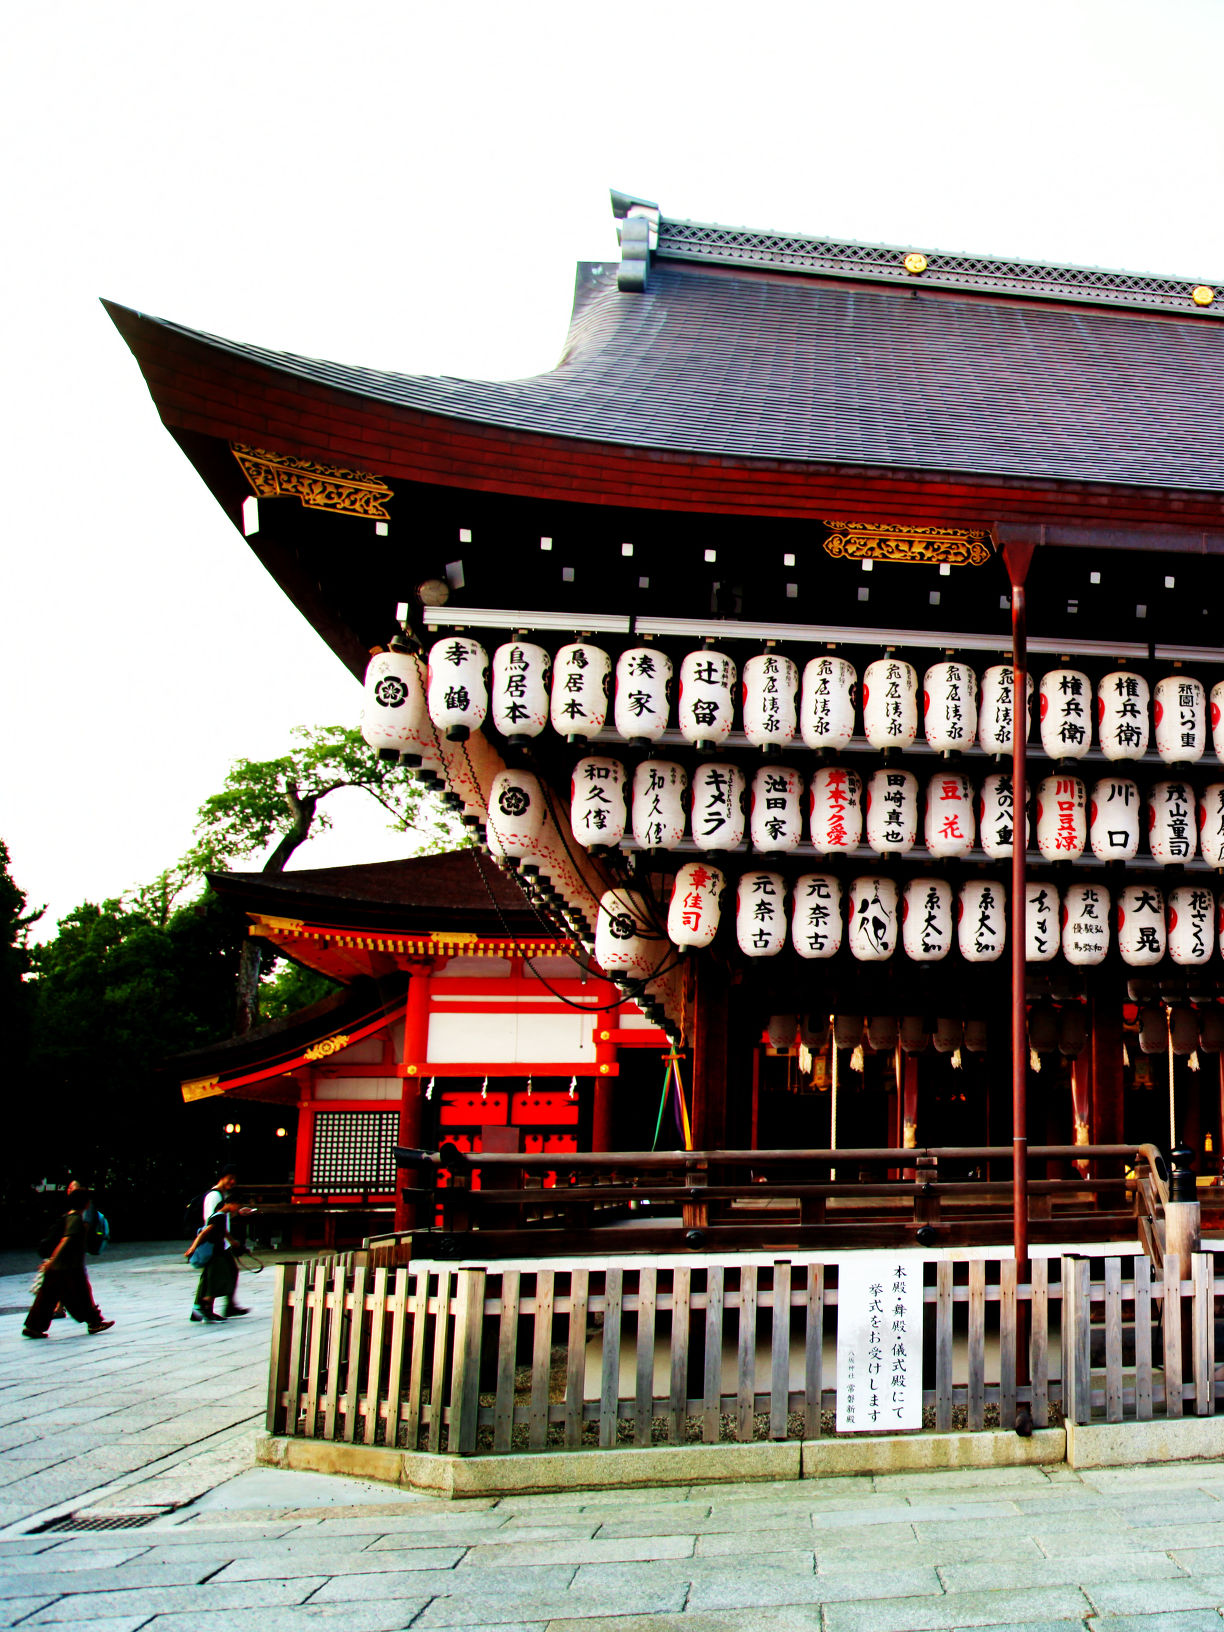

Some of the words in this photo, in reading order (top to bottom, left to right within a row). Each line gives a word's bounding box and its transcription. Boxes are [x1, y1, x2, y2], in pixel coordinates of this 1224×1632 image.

[445, 641, 471, 711] 孝鶴
[504, 647, 530, 724] 鳥居本
[562, 649, 588, 720] 鳥居本
[628, 654, 657, 717] 湊家
[692, 661, 720, 727] 辻留
[1058, 676, 1085, 745] 権兵衛
[1115, 677, 1142, 747] 権兵衛
[701, 769, 727, 836] キメラ
[764, 774, 788, 840] 池田家
[882, 774, 907, 843] 田崎真也
[938, 780, 964, 839] 豆花
[1107, 783, 1130, 849] 川口
[752, 875, 776, 948] 元奈古
[806, 878, 831, 951] 元奈古
[1080, 889, 1099, 919] 北尾
[1133, 890, 1161, 953] 大晃
[1188, 891, 1209, 957] 花さくら
[868, 1284, 883, 1422] 挙式をお受けします
